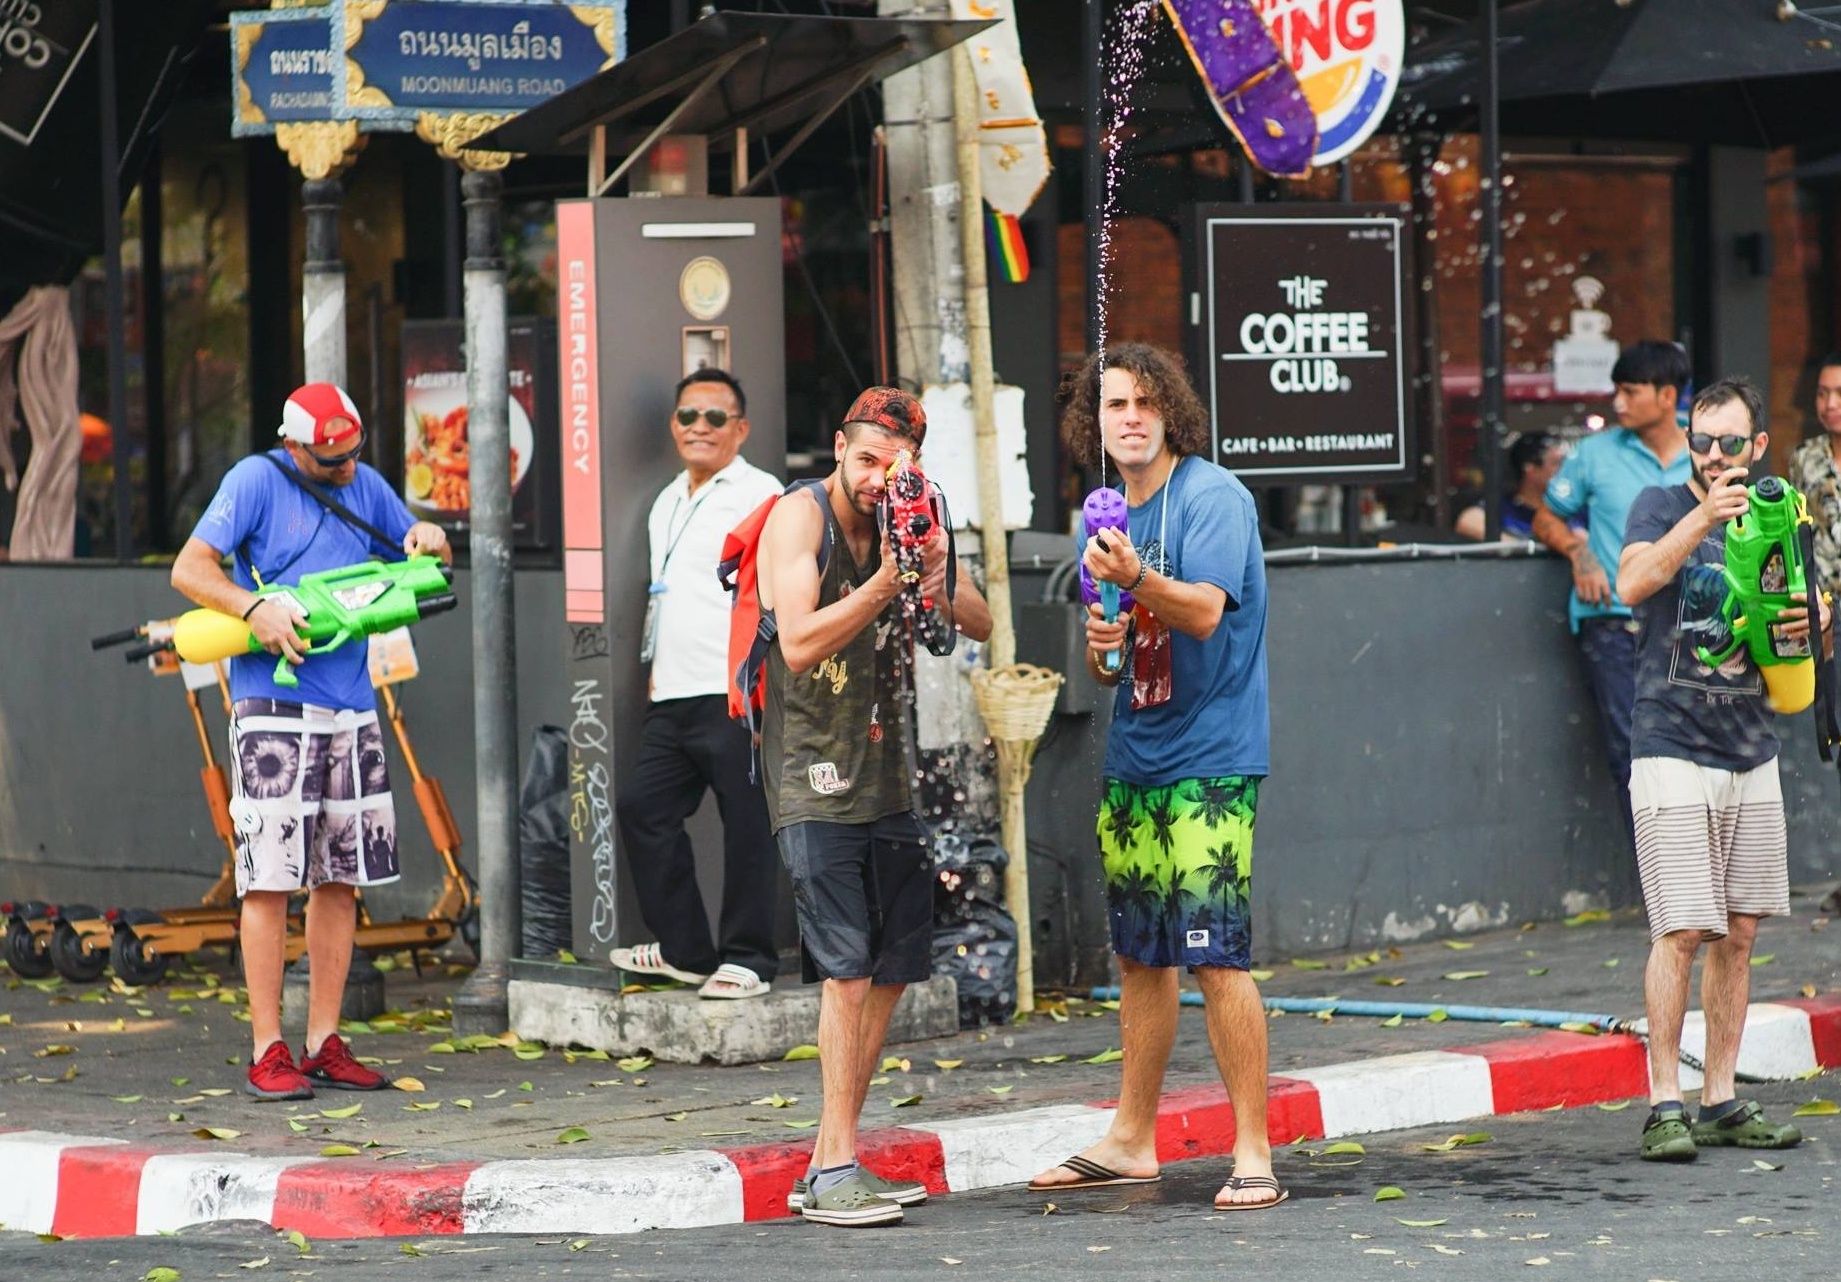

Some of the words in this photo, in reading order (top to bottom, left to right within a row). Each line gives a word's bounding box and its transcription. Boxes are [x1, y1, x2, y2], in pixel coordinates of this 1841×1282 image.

[398, 20, 564, 71] ถนนมูลเมือง
[401, 75, 514, 94] MOONMUANG
[517, 77, 567, 95] ROAD
[1277, 275, 1328, 309] THE
[1239, 312, 1369, 354] COFFEE
[568, 260, 590, 474] EMERGENCY
[1221, 437, 1258, 454] CAFE
[1267, 436, 1296, 452] BAR
[1305, 433, 1394, 451] RESTAURANT
